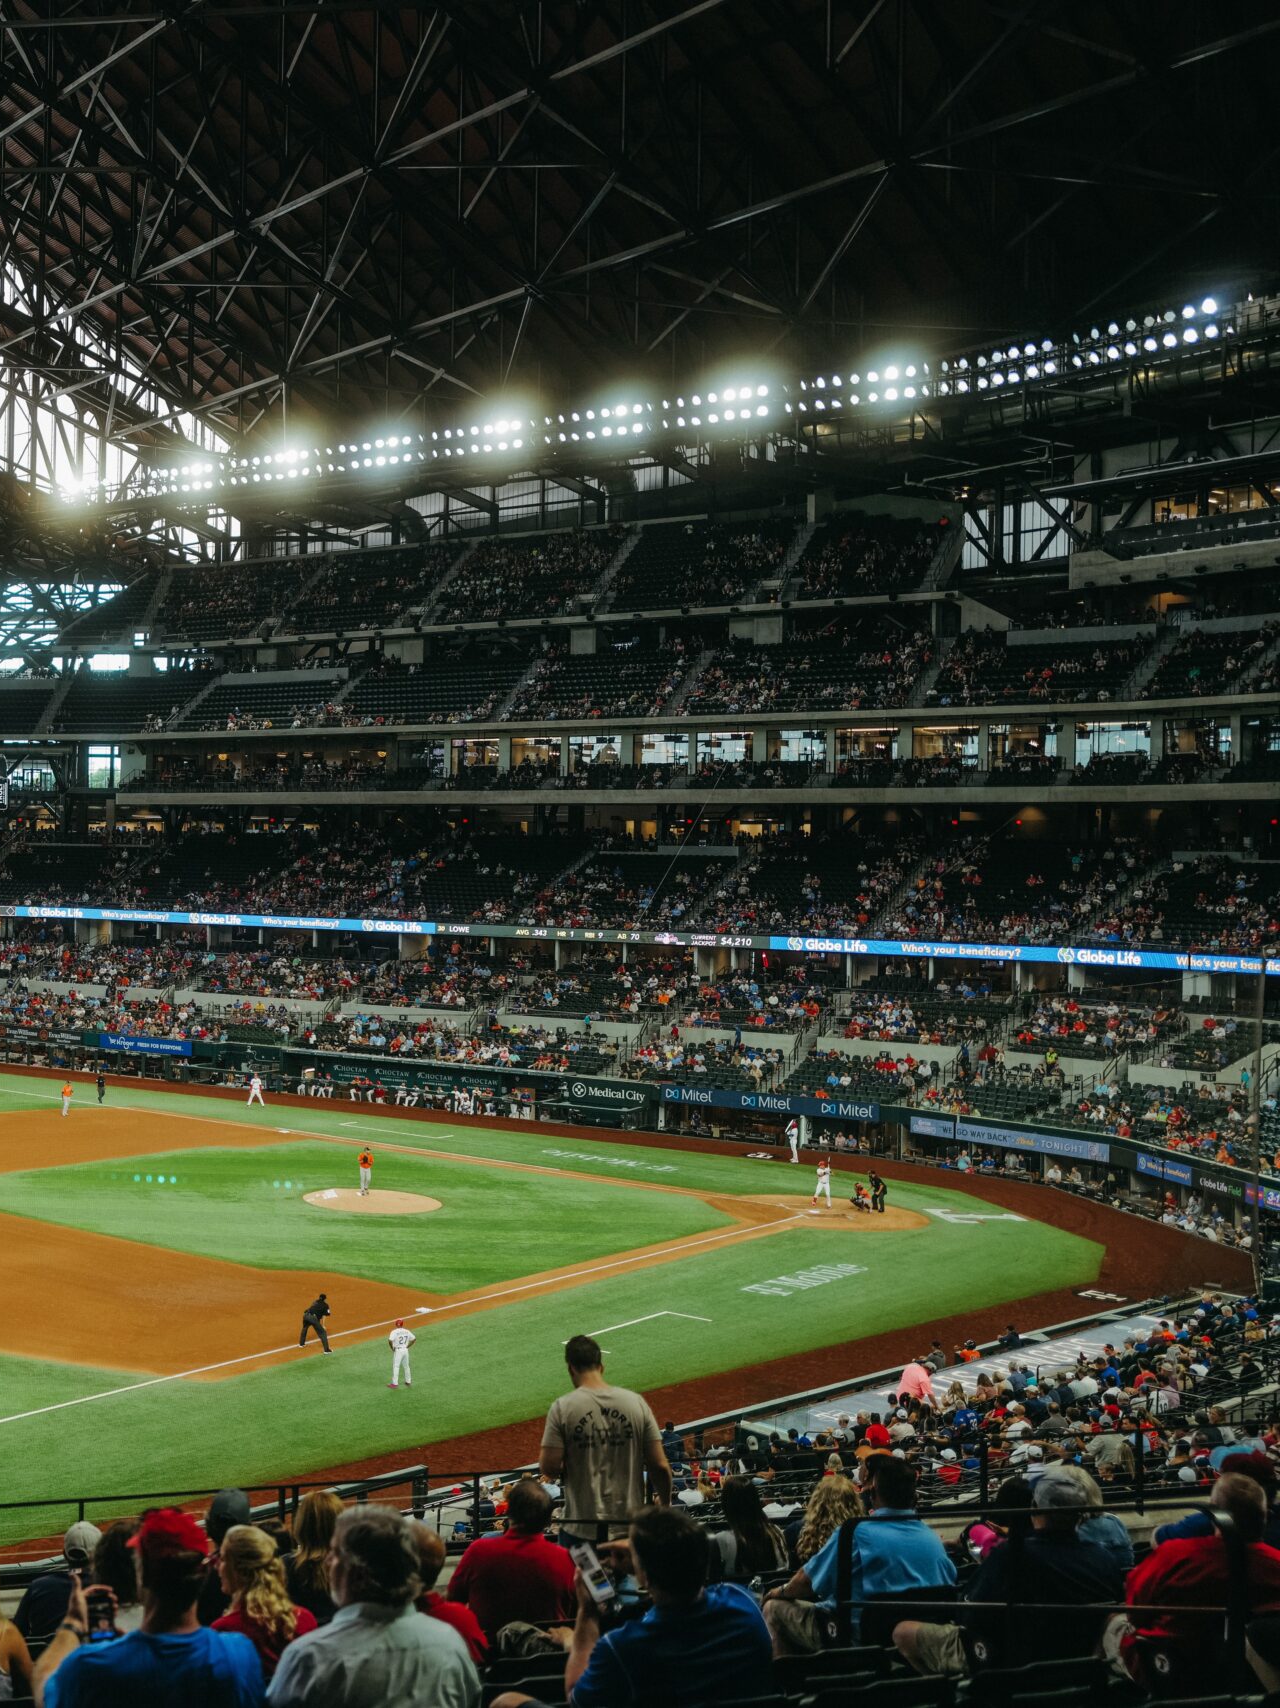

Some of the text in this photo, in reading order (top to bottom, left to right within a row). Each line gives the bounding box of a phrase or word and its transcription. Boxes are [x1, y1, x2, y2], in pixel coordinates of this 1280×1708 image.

[41, 908, 83, 918] Globe Life
[201, 914, 241, 924] Globe Life
[300, 920, 339, 928] beneficiary?
[721, 938, 751, 947] $4,210
[806, 939, 867, 952] Globe Life
[901, 944, 1020, 958] Who's your beneficiary?
[1077, 948, 1141, 965] Globe Life
[160, 1043, 183, 1051] EVERYONE.
[337, 1065, 368, 1073] CHOCTAW
[588, 1086, 645, 1102] Medical City
[682, 1088, 711, 1103] Mitel
[759, 1096, 790, 1111] Mitel
[839, 1102, 872, 1118] Mitel
[957, 1127, 968, 1136] GO
[971, 1129, 985, 1139] WAY
[1041, 1139, 1083, 1153] TONIGHT
[1200, 1178, 1216, 1190] Globe
[1217, 1182, 1227, 1193] Life
[1228, 1185, 1241, 1197] Field
